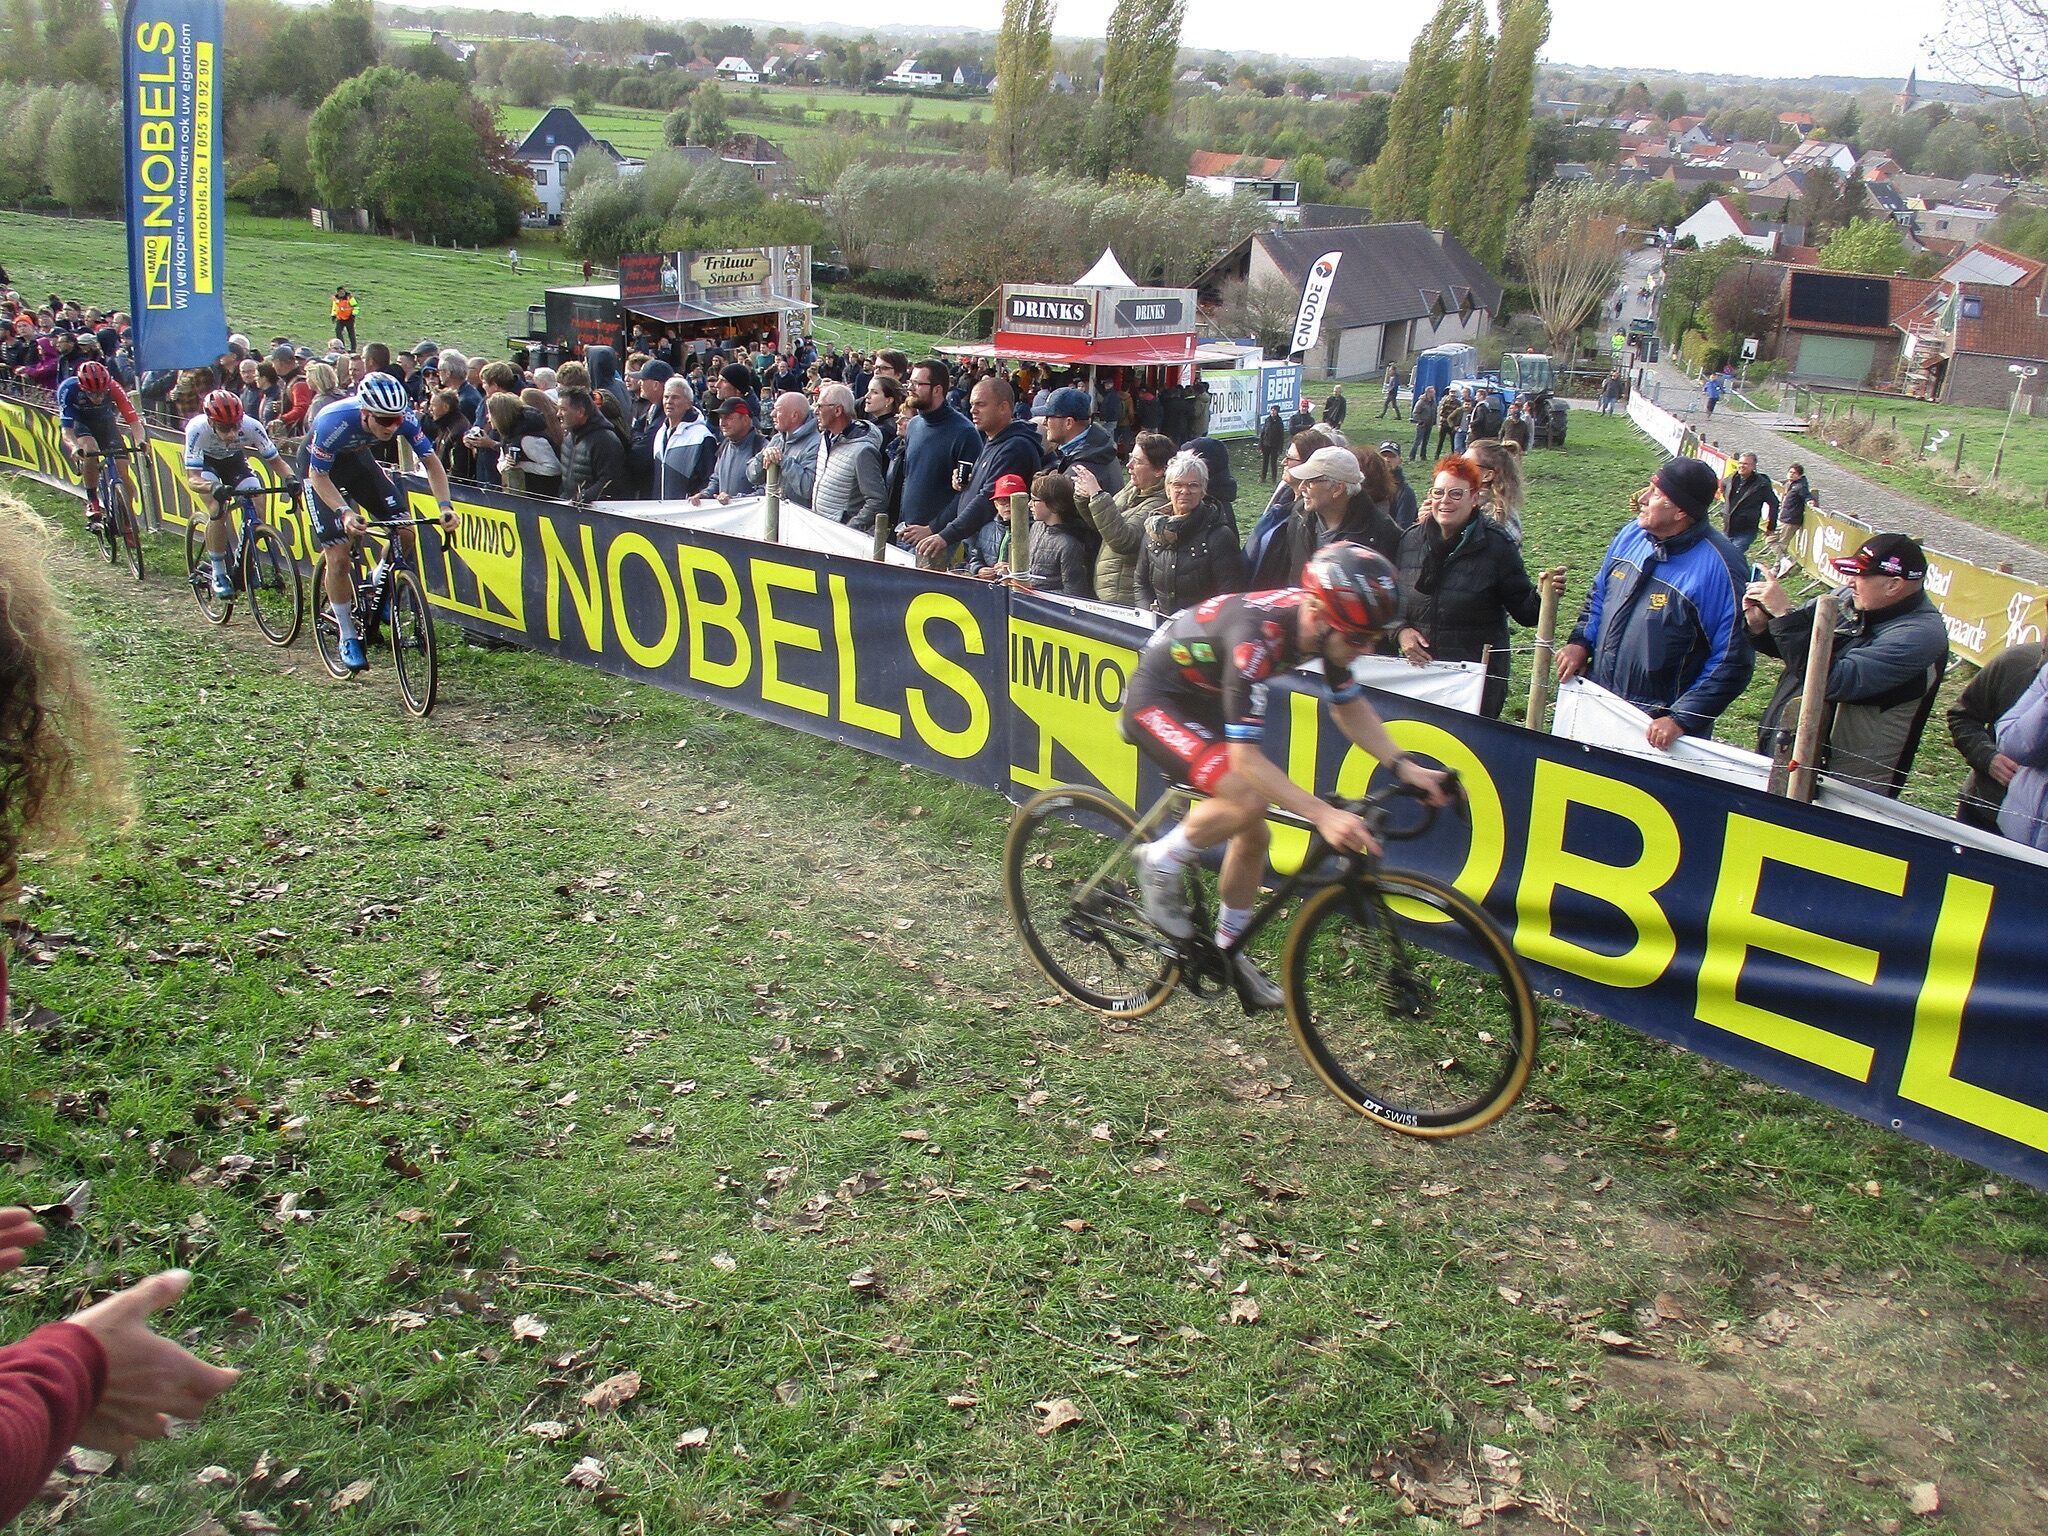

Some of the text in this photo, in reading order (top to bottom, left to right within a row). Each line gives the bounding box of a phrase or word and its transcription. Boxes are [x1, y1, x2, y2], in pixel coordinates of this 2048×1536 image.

[136, 21, 176, 227] NOBELS
[174, 23, 193, 310] Wij verkopen en verhuren ook uw eigendom
[196, 166, 209, 279] www.nobels.be
[147, 239, 158, 274] IMMO
[704, 256, 757, 270] Frituur
[708, 271, 754, 285] Snacks
[1012, 300, 1085, 321] DRINKS
[1135, 304, 1166, 321] DRINKS
[1297, 284, 1323, 347] CNUDDE
[1267, 376, 1296, 401] BERT
[461, 512, 517, 558] IMMO
[1923, 563, 1954, 597] Stad
[538, 515, 991, 759] NOBELS
[1011, 632, 1126, 713] IMMO
[1362, 1099, 1418, 1127] DT SWISS
